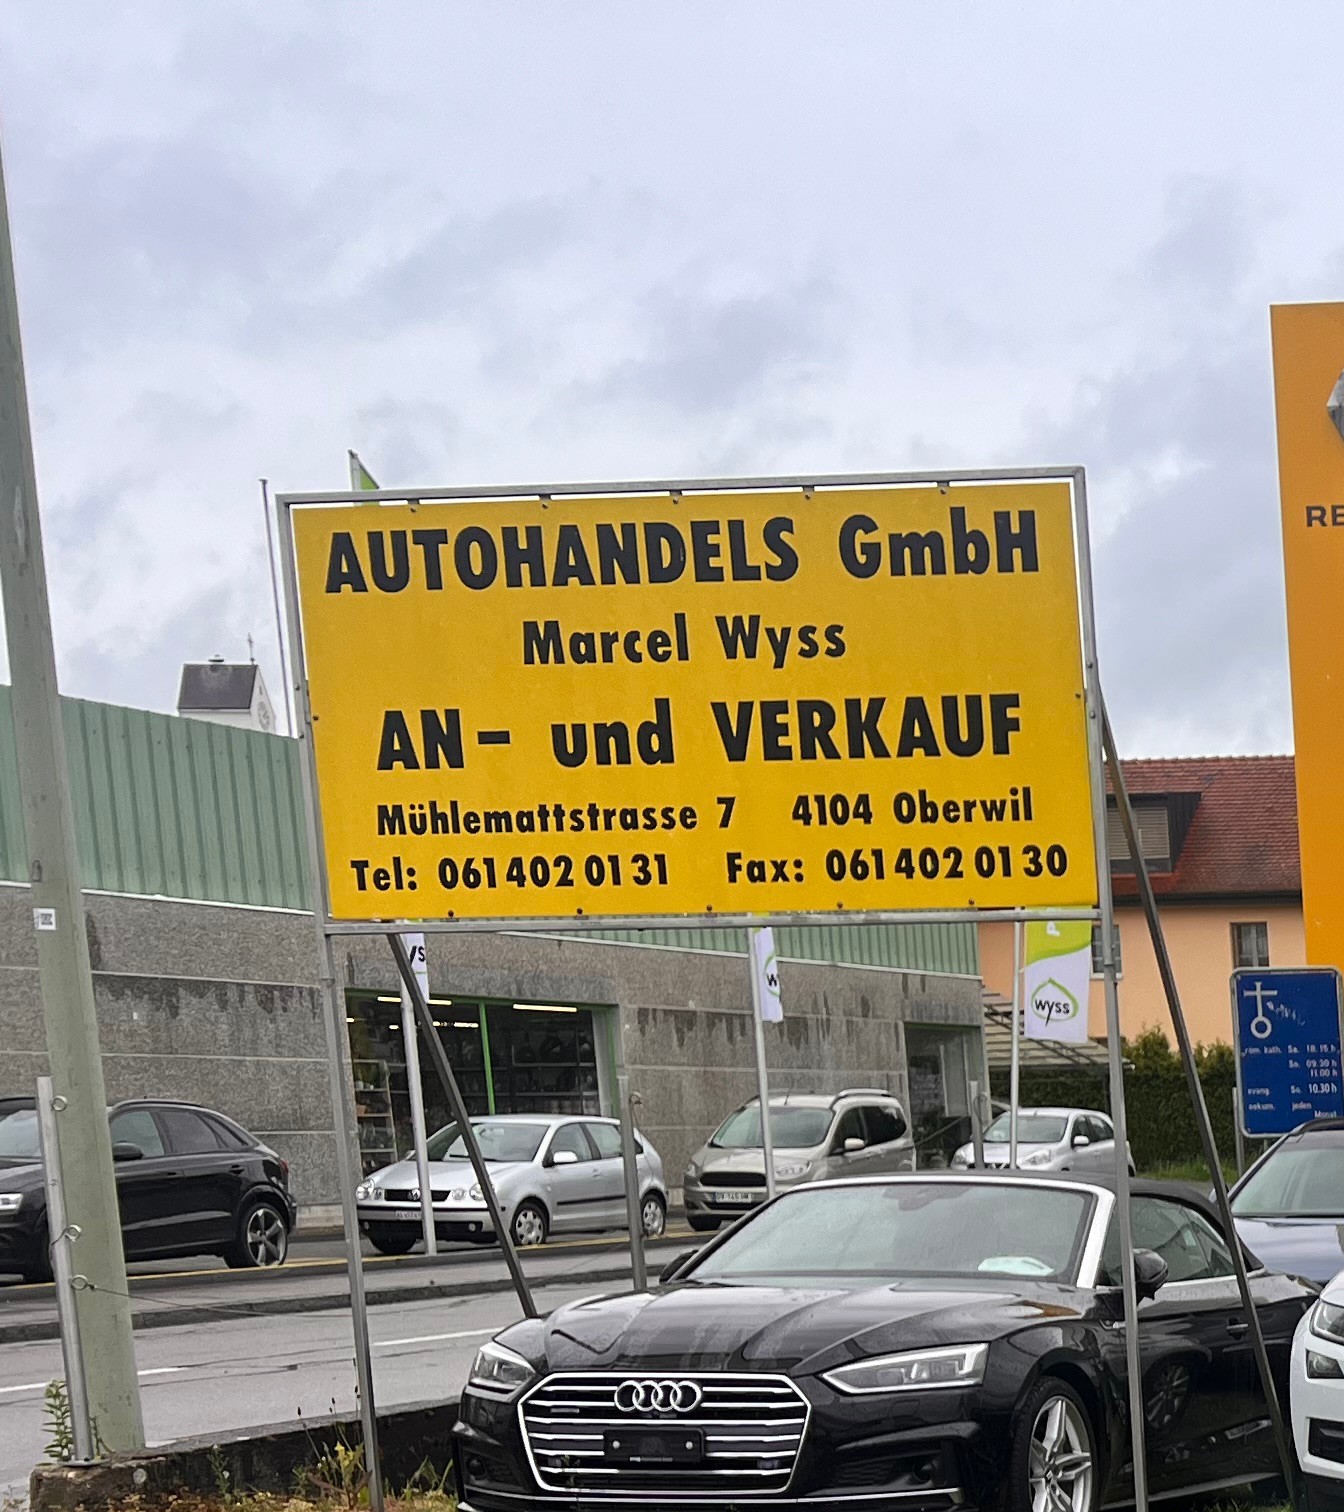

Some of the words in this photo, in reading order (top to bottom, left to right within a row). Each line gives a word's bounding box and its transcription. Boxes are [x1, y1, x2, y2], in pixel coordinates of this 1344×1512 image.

[326, 516, 799, 594] AUTOHANDELS
[838, 506, 1039, 579] GmbH
[522, 612, 690, 665] Marcel
[714, 614, 846, 670] Wyss
[550, 697, 675, 768] und
[710, 693, 1021, 762] VERKAUF
[377, 800, 697, 836] Mühlemattstrasse
[716, 796, 736, 829] 7
[792, 793, 873, 826] 4104
[893, 786, 1033, 825] Oberwil
[350, 856, 417, 891] Tel:
[726, 852, 804, 884] Fax:
